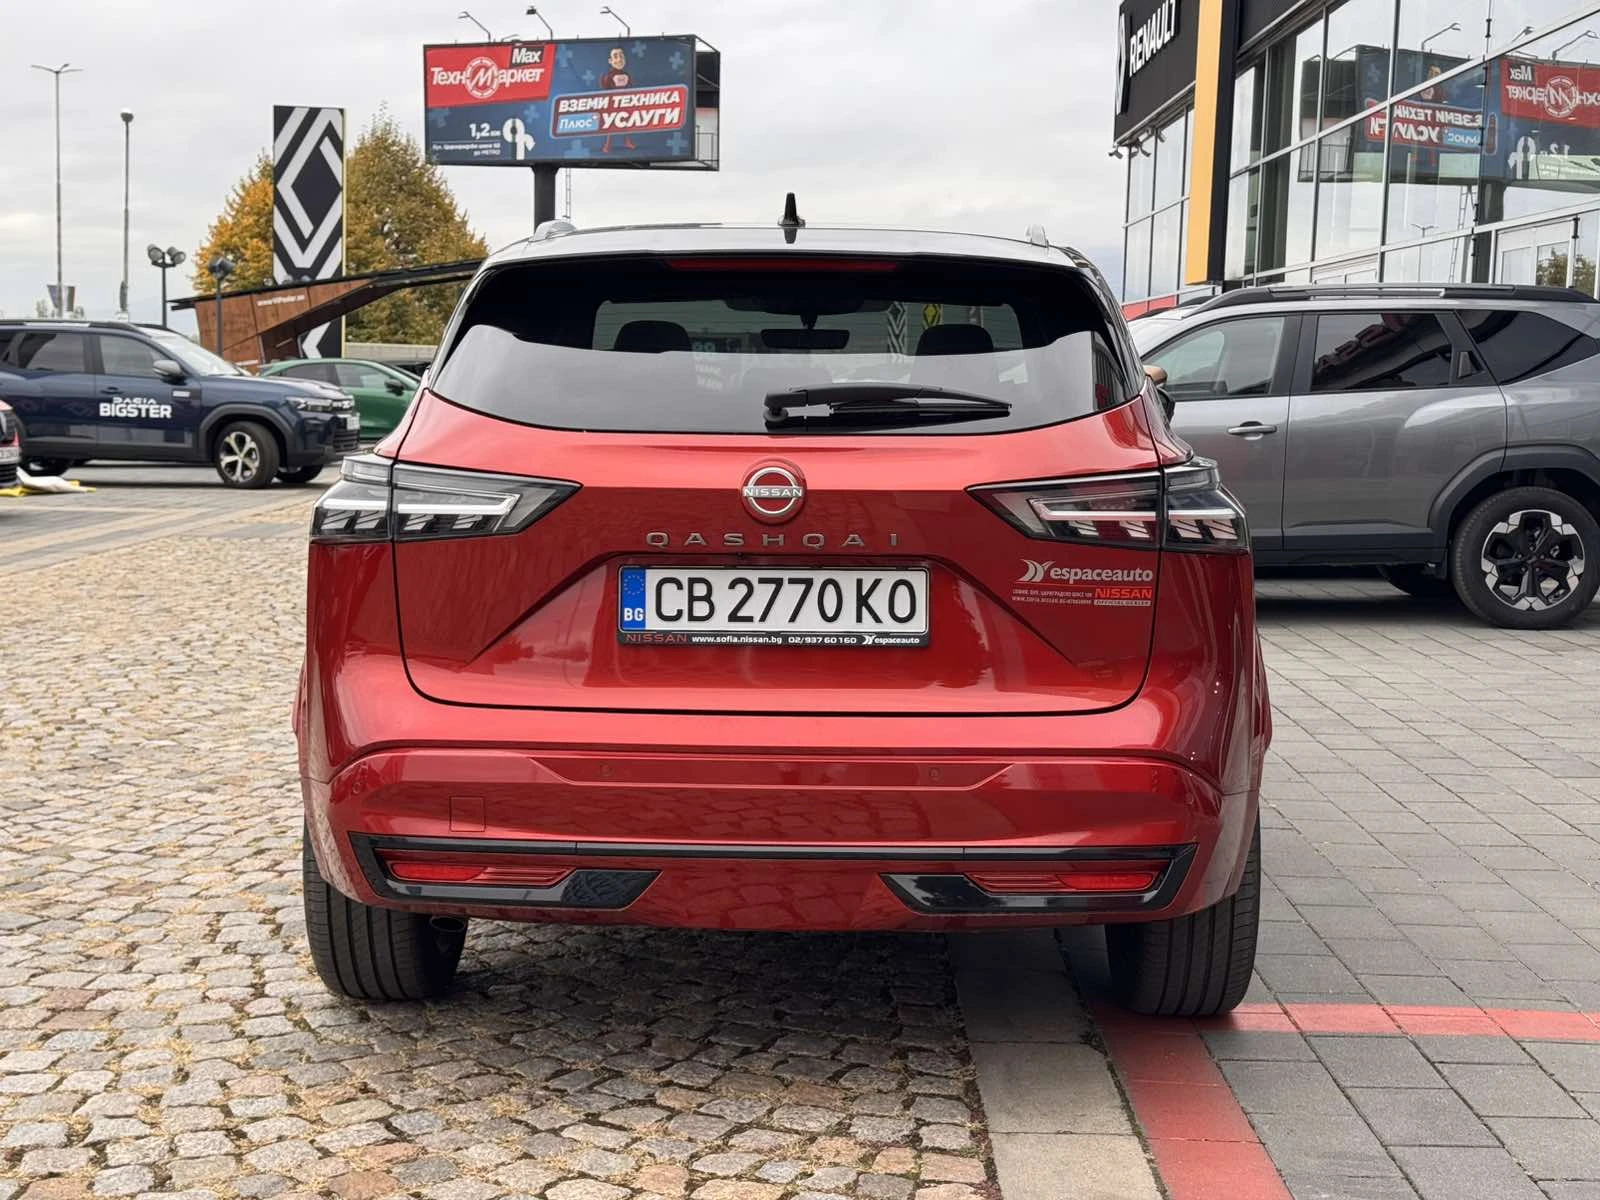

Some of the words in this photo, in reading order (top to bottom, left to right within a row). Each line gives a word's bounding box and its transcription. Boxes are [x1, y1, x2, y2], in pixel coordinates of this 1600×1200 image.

[1129, 0, 1175, 77] RENAULT
[512, 48, 541, 63] Max
[559, 96, 612, 112] ВЗЕМИ
[612, 91, 680, 108] ТЕХНИКА
[602, 107, 680, 129] УСЛУГИ
[469, 123, 490, 139] 1,2
[99, 402, 172, 418] BIGSTER
[744, 487, 802, 497] NISSAN
[646, 532, 898, 547] QASHQAI
[1050, 567, 1153, 584] espaceauto
[655, 577, 715, 622] CB
[727, 577, 843, 623] 2770
[855, 578, 917, 623] KO
[1094, 588, 1152, 599] NISSAN
[624, 608, 644, 621] BG
[626, 634, 687, 642] NISSAN
[692, 635, 782, 645] www.sofia.nissan.bg
[875, 636, 920, 645] espaceauto
